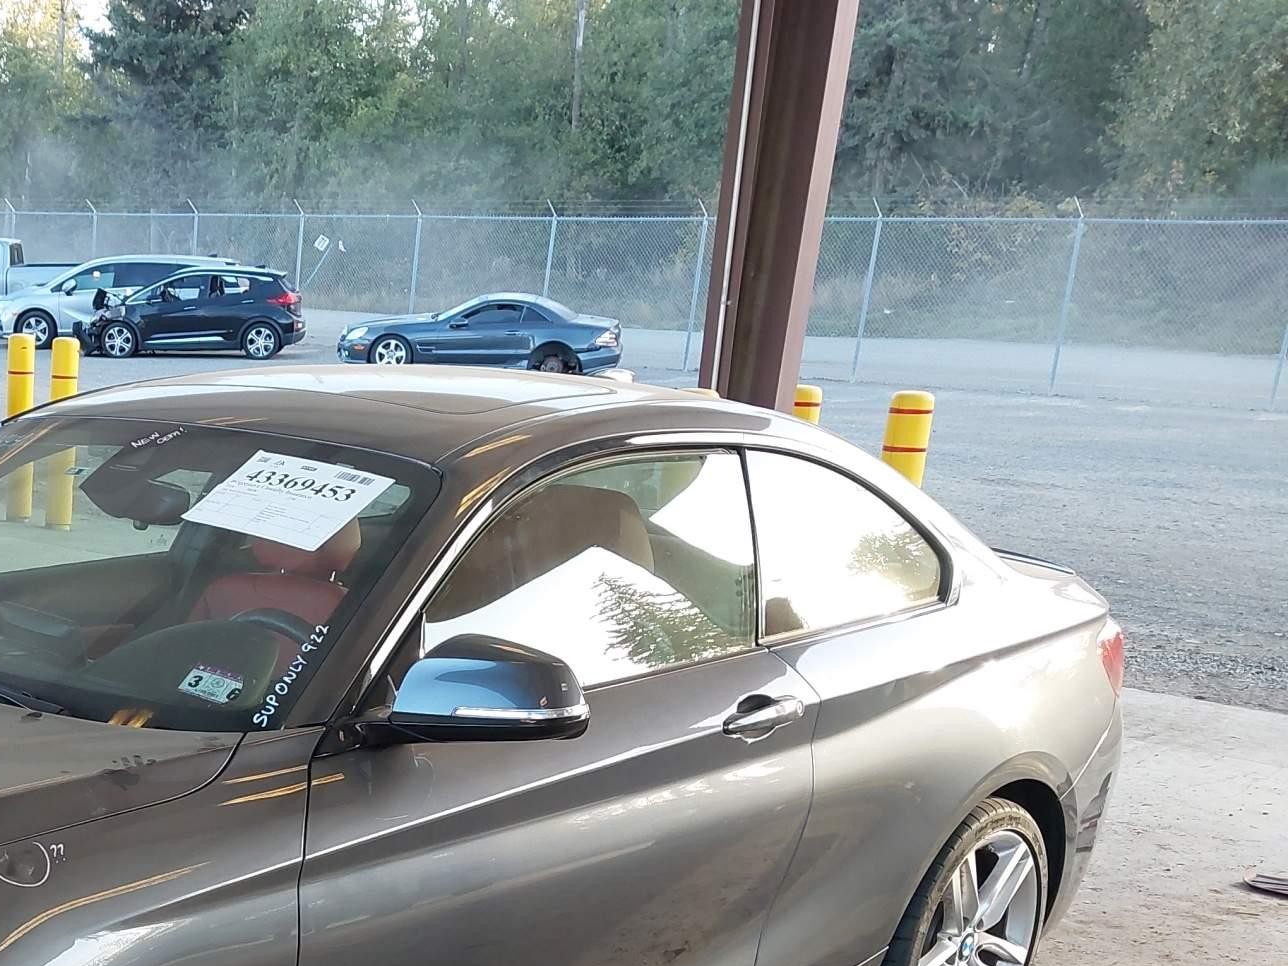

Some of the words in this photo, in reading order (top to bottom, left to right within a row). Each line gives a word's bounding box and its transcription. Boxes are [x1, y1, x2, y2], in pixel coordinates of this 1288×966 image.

[246, 469, 357, 502] 43369453
[187, 675, 204, 688] 3
[252, 694, 279, 727] SUP
[274, 654, 308, 695] ONLY
